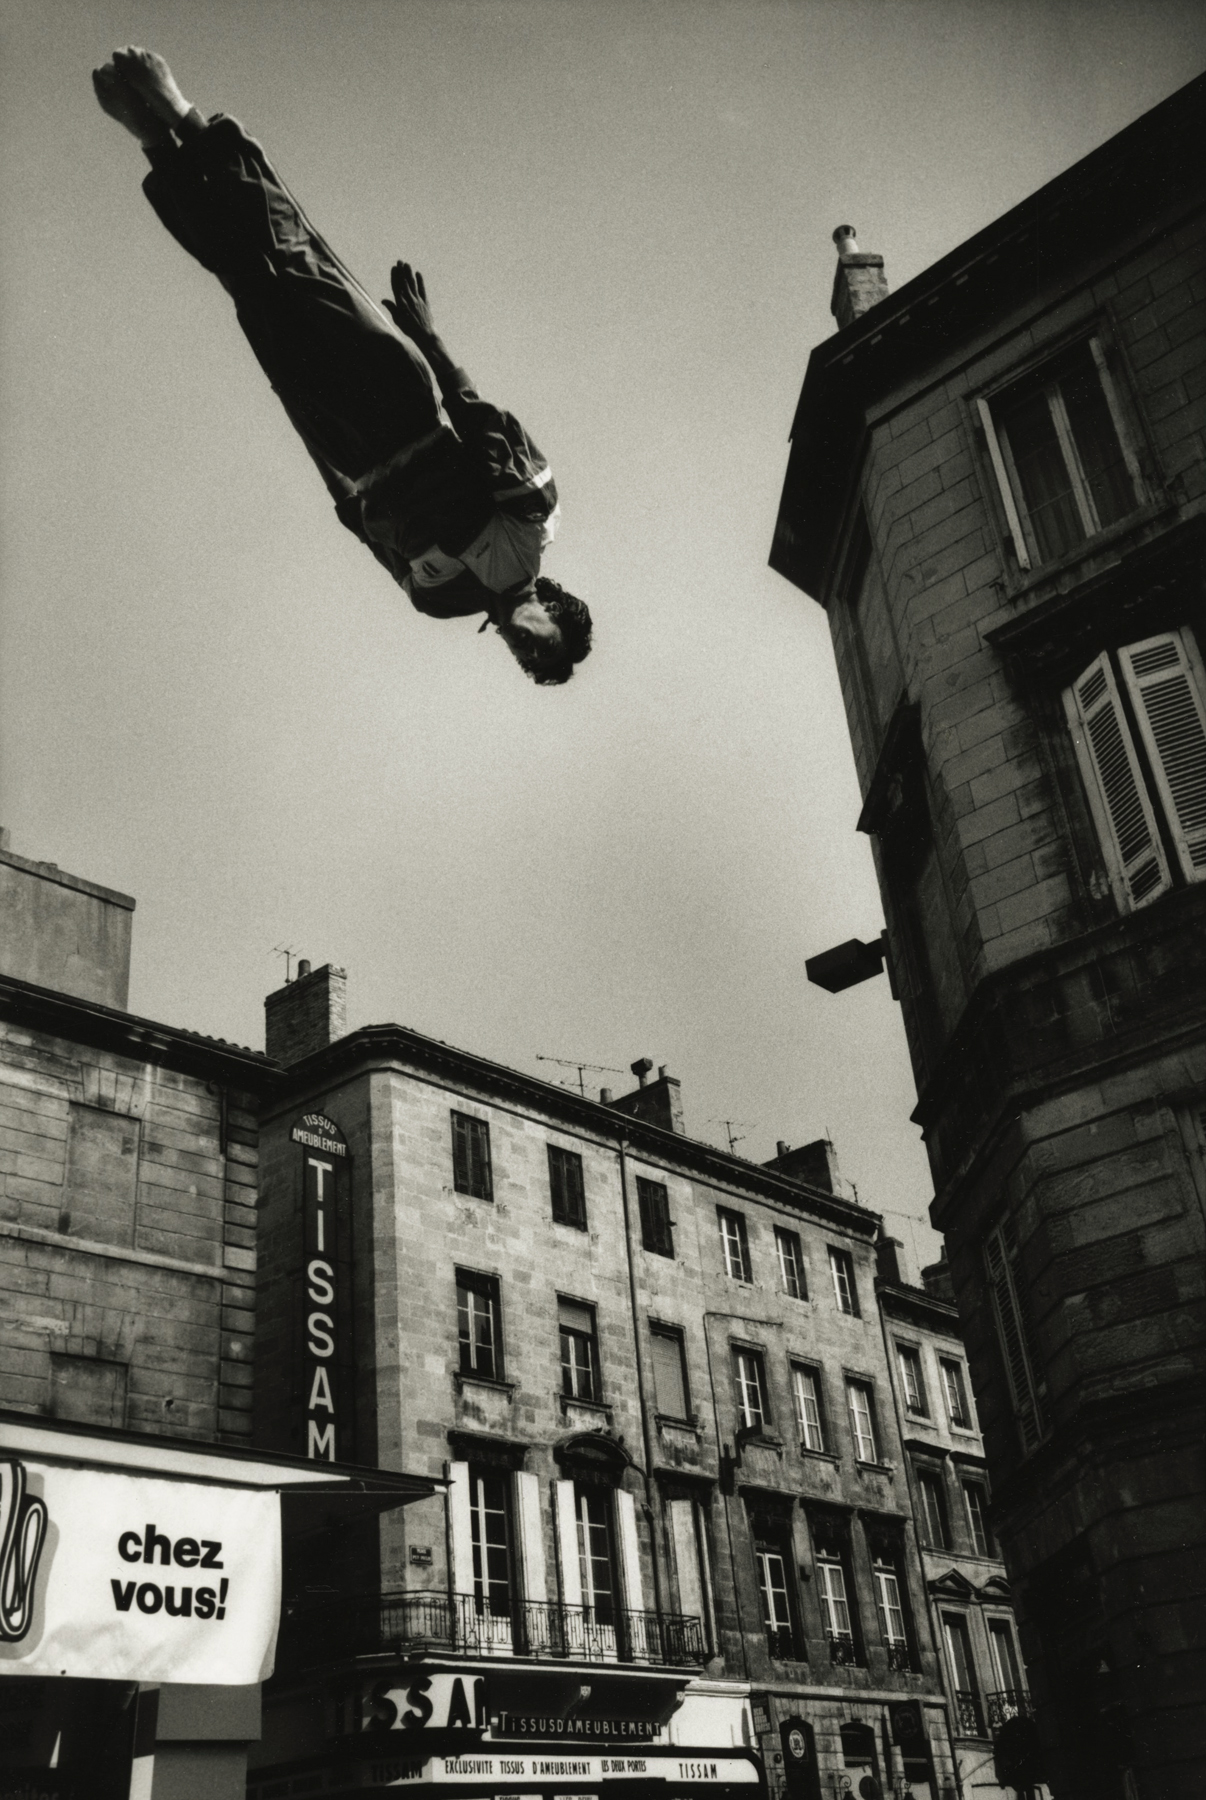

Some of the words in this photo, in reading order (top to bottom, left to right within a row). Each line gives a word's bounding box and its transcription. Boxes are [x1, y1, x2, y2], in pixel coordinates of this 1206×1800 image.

[303, 1114, 337, 1134] TISSUS
[292, 1128, 346, 1157] AMEUBLEMENT
[307, 1157, 336, 1462] TISSAM
[117, 1524, 224, 1570] chez
[110, 1577, 229, 1621] vous!
[372, 1760, 422, 1783] TISSAM
[445, 1760, 493, 1775] EXCLUSIVITE
[500, 1761, 525, 1775] TISSUS
[532, 1761, 591, 1775] D'AMEUBLEMENT
[611, 1760, 625, 1773] DEUX
[627, 1760, 647, 1773] PORTES
[679, 1763, 718, 1779] TISSAM
